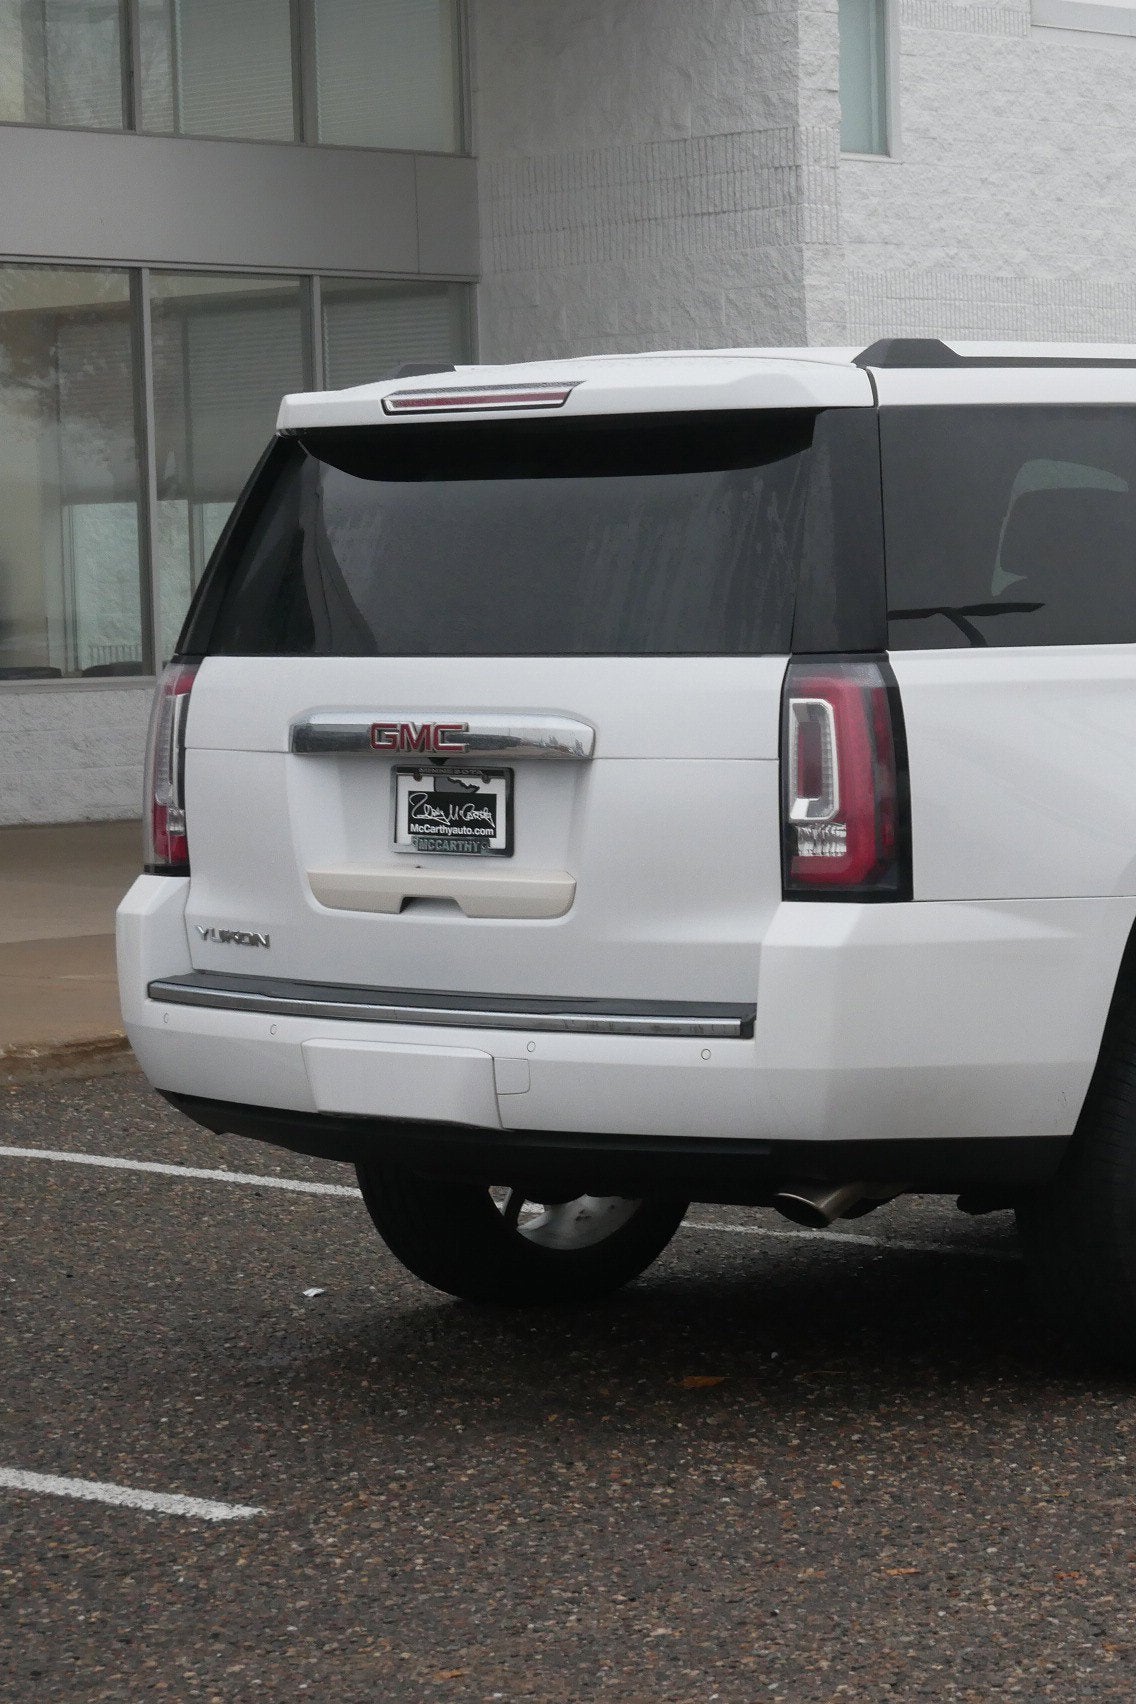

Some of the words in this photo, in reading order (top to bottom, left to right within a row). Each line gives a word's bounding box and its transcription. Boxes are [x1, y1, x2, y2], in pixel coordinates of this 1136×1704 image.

[369, 721, 470, 753] GMC
[418, 766, 484, 776] MINNESOTA
[410, 823, 495, 836] McCarthyauto.com
[195, 925, 271, 949] YUKON
